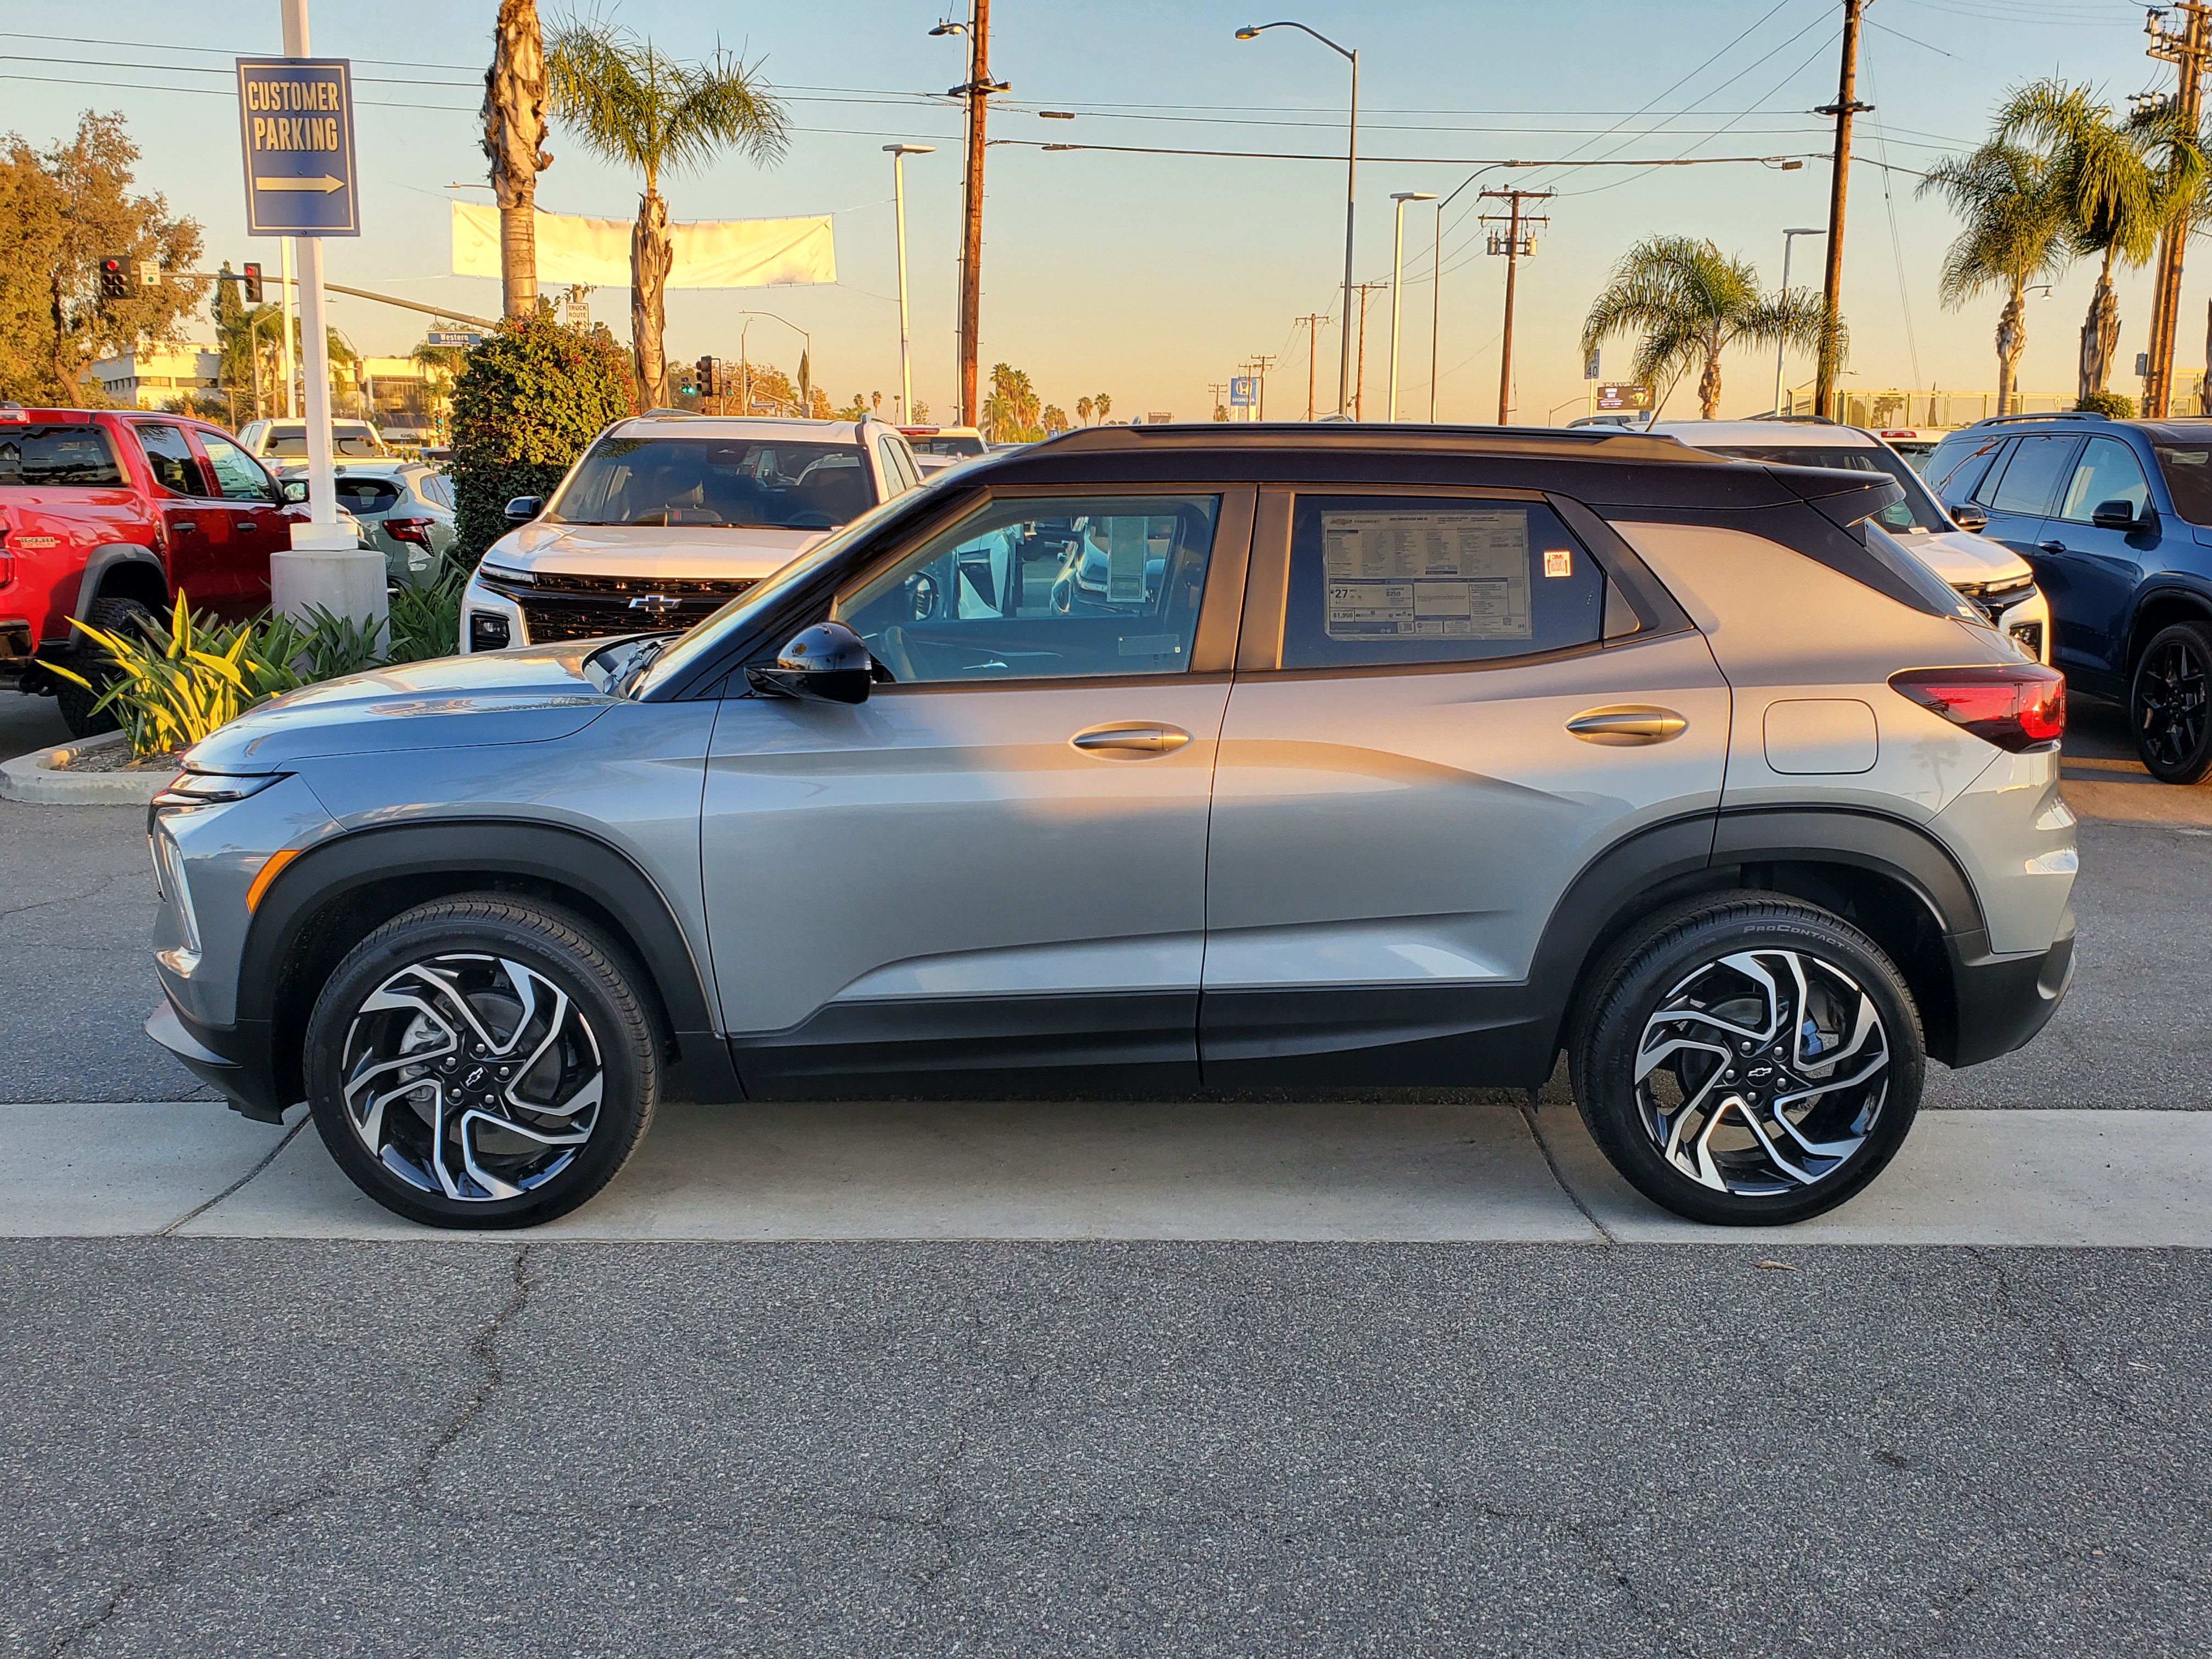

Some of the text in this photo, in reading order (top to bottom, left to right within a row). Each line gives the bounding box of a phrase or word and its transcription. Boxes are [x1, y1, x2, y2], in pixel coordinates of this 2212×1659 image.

[248, 81, 340, 111] CUSTOMER
[253, 117, 338, 151] PARKING
[1587, 366, 1598, 377] 40
[1335, 589, 1348, 599] 27
